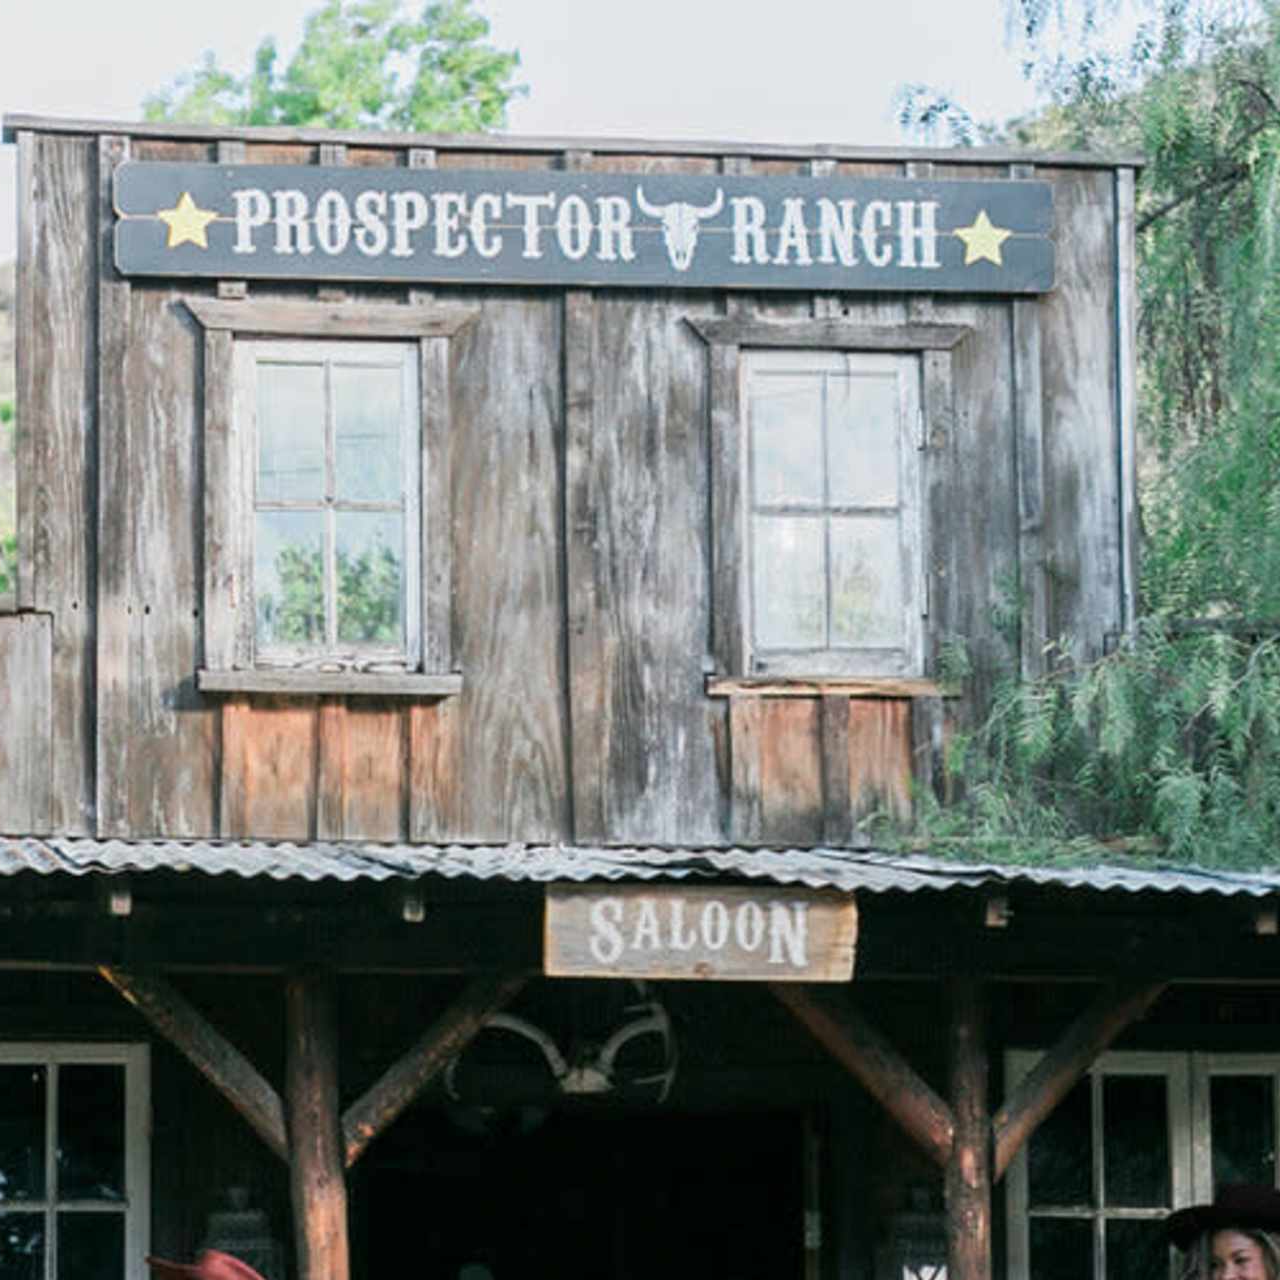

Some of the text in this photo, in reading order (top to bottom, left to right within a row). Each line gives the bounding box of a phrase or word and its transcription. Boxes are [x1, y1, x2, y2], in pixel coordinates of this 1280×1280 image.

[232, 189, 942, 269] PROSPECTOR RANCH
[588, 898, 809, 967] SALOON
